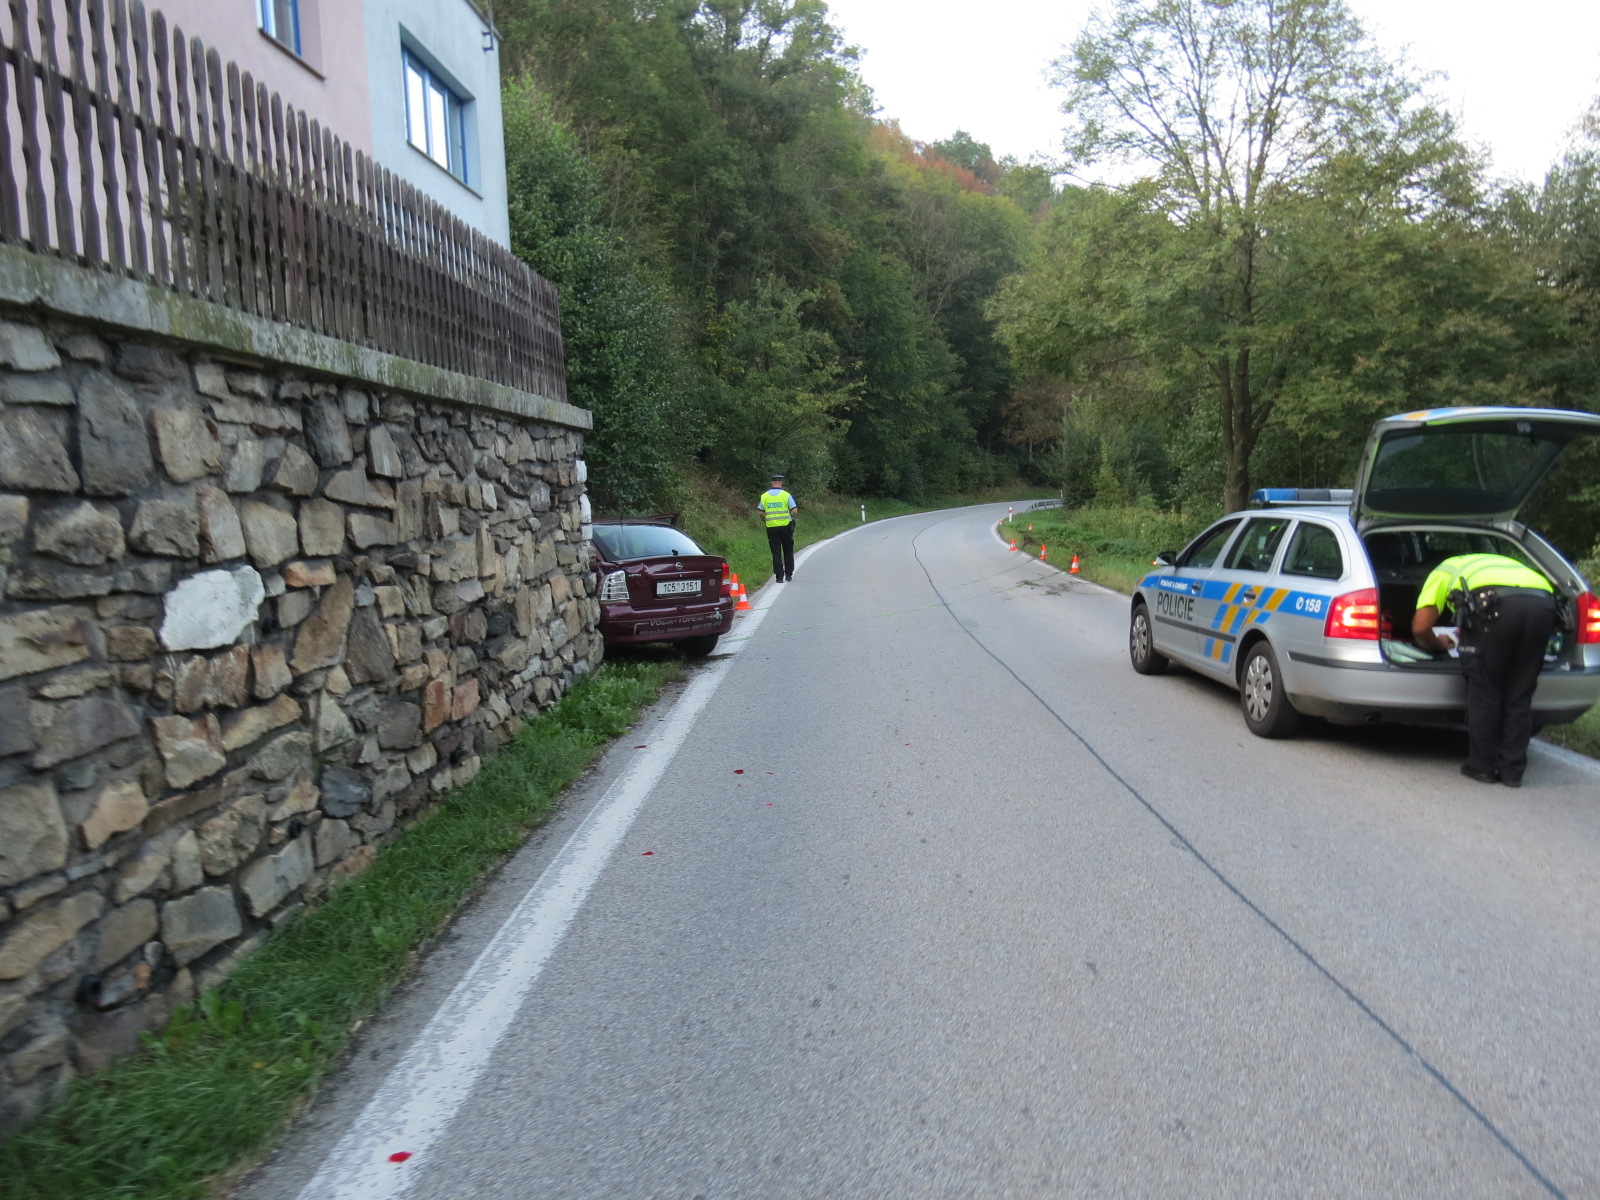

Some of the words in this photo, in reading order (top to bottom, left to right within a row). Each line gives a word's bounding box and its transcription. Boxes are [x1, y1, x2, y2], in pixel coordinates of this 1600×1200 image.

[663, 583, 676, 593] 1C5
[681, 581, 698, 592] 3151
[1157, 592, 1194, 621] POLICIE
[1305, 598, 1321, 613] 158
